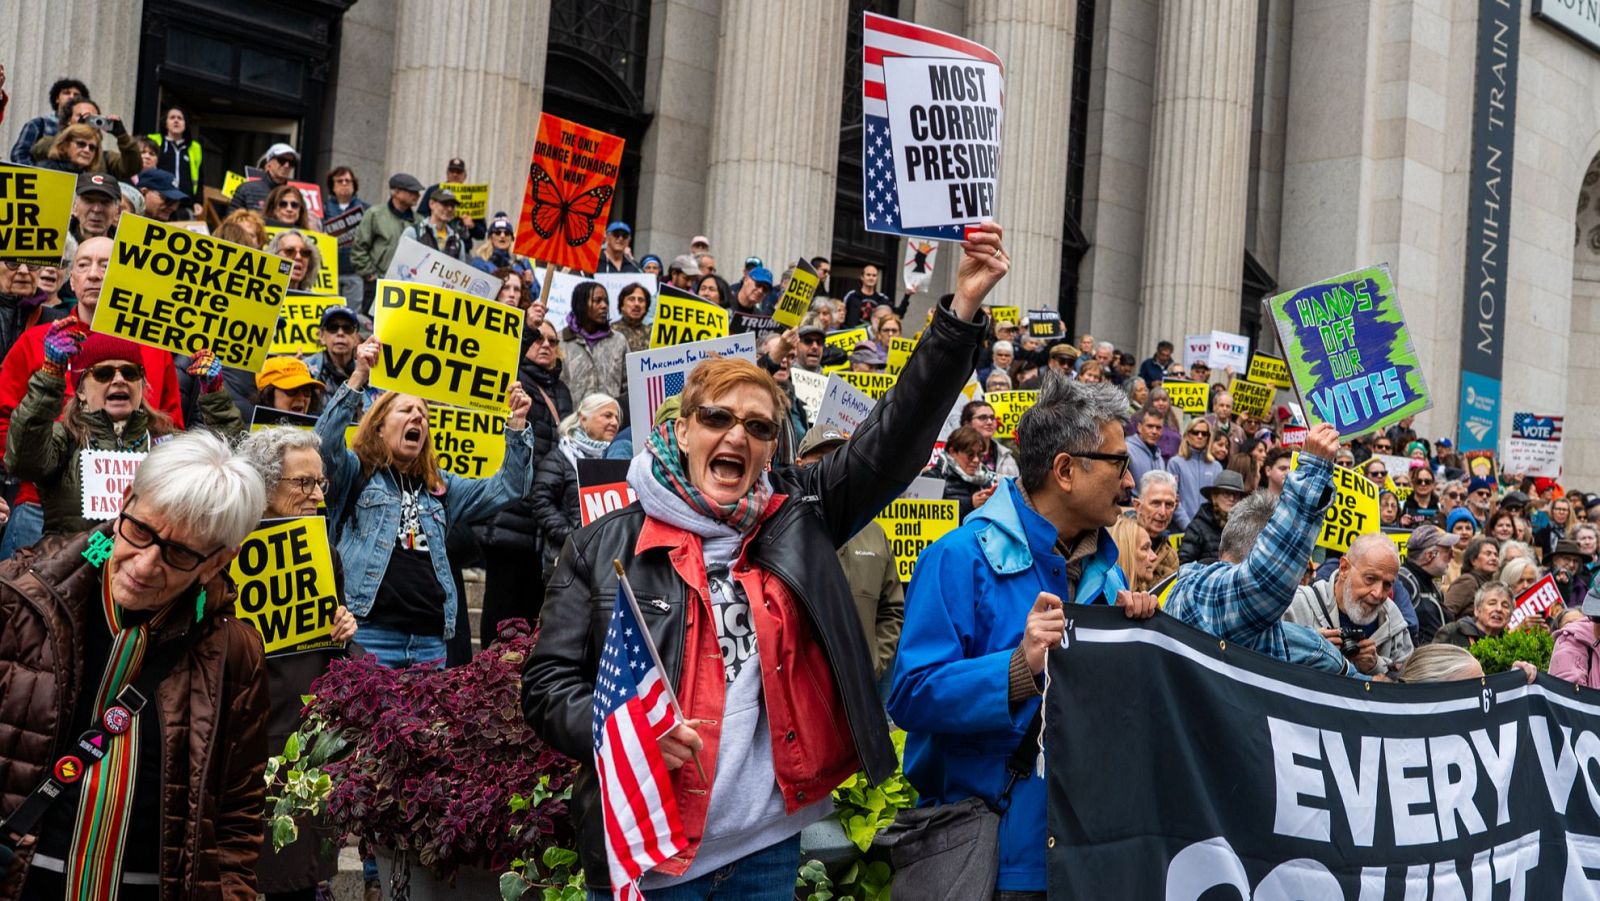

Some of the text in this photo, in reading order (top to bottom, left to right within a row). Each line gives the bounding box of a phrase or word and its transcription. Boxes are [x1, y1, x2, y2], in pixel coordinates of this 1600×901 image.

[928, 64, 986, 103] MOST
[1488, 19, 1510, 132] TRAIN
[909, 104, 998, 142] CORRUPT
[561, 131, 600, 155] THE ONLY
[534, 140, 618, 180] ORANGE MONARCH
[0, 172, 38, 200] TE
[563, 167, 587, 188] WANT
[0, 202, 40, 227] UR
[143, 223, 272, 280] POSTAL
[1477, 145, 1502, 355] MOYNIHAN
[118, 241, 283, 306] WORKERS
[171, 283, 229, 313] are
[382, 285, 520, 339] DELIVER
[1296, 280, 1373, 328] HANDS
[109, 287, 268, 347] ELECTION
[659, 303, 724, 330] DEFEAT
[1033, 323, 1054, 335] VOTE
[114, 312, 254, 366] HEROES!
[424, 322, 480, 359] the
[656, 323, 723, 346] MAG
[1190, 344, 1211, 353] VO
[1215, 340, 1245, 354] VOTE
[1318, 315, 1356, 356] OFF
[382, 343, 511, 403] VOTE!
[1250, 367, 1291, 382] DEMOCRAC
[1252, 359, 1288, 373] DEFEN
[1327, 347, 1365, 380] OUR
[990, 391, 1037, 403] DEFEN
[1232, 391, 1268, 405] CONVICT
[1235, 380, 1272, 397] IMPEACH
[1311, 366, 1406, 430] VOTES
[429, 407, 506, 436] EFEND
[1003, 413, 1020, 424] PO
[1522, 426, 1551, 438] VOTE
[433, 430, 475, 454] the
[437, 452, 488, 477] OST
[90, 495, 124, 513] FASC
[877, 502, 954, 521] LLIONAIRES
[1325, 505, 1367, 531] OST
[894, 520, 922, 536] and
[88, 531, 115, 560] FUC
[238, 525, 313, 577] OTE
[240, 566, 320, 613] OUR
[240, 595, 339, 645] WER
[1266, 714, 1600, 847] EVERY VO
